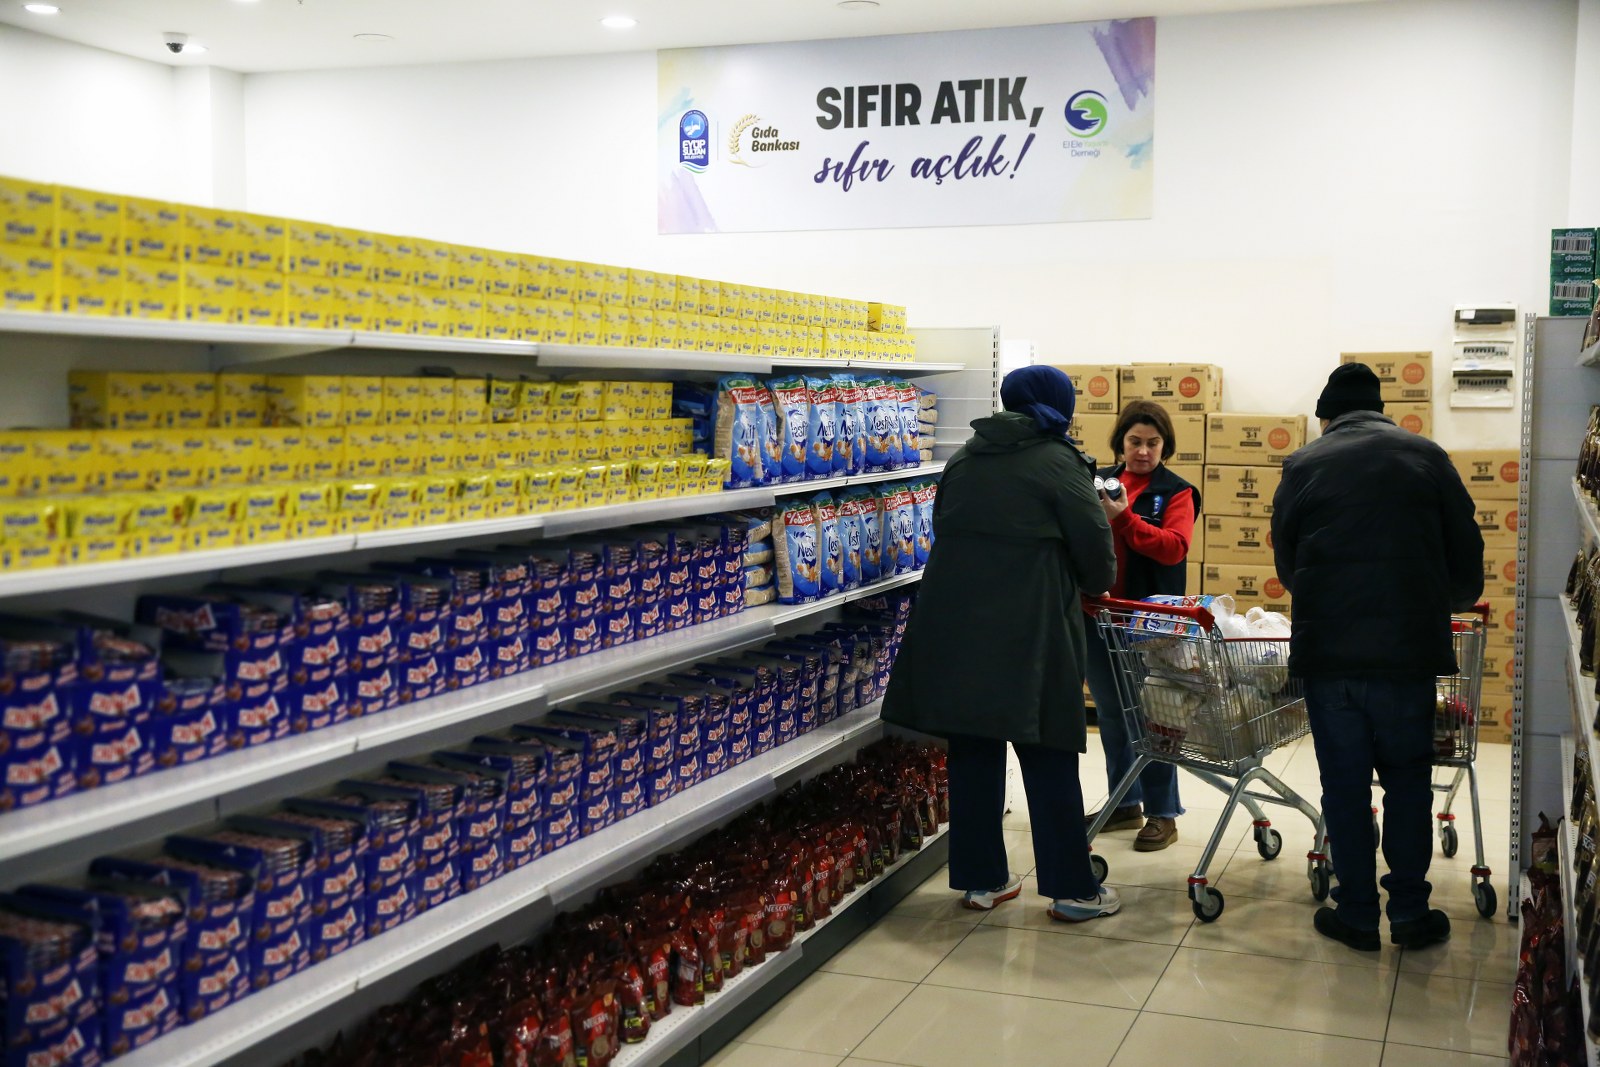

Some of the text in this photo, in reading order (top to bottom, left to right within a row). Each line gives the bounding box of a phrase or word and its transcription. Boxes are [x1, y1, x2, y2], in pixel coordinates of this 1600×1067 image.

[816, 76, 1044, 130] SIFIR ATIK,
[751, 126, 779, 138] Gıda
[751, 139, 800, 152] Bankası
[813, 132, 1036, 193] sıfır açlık!
